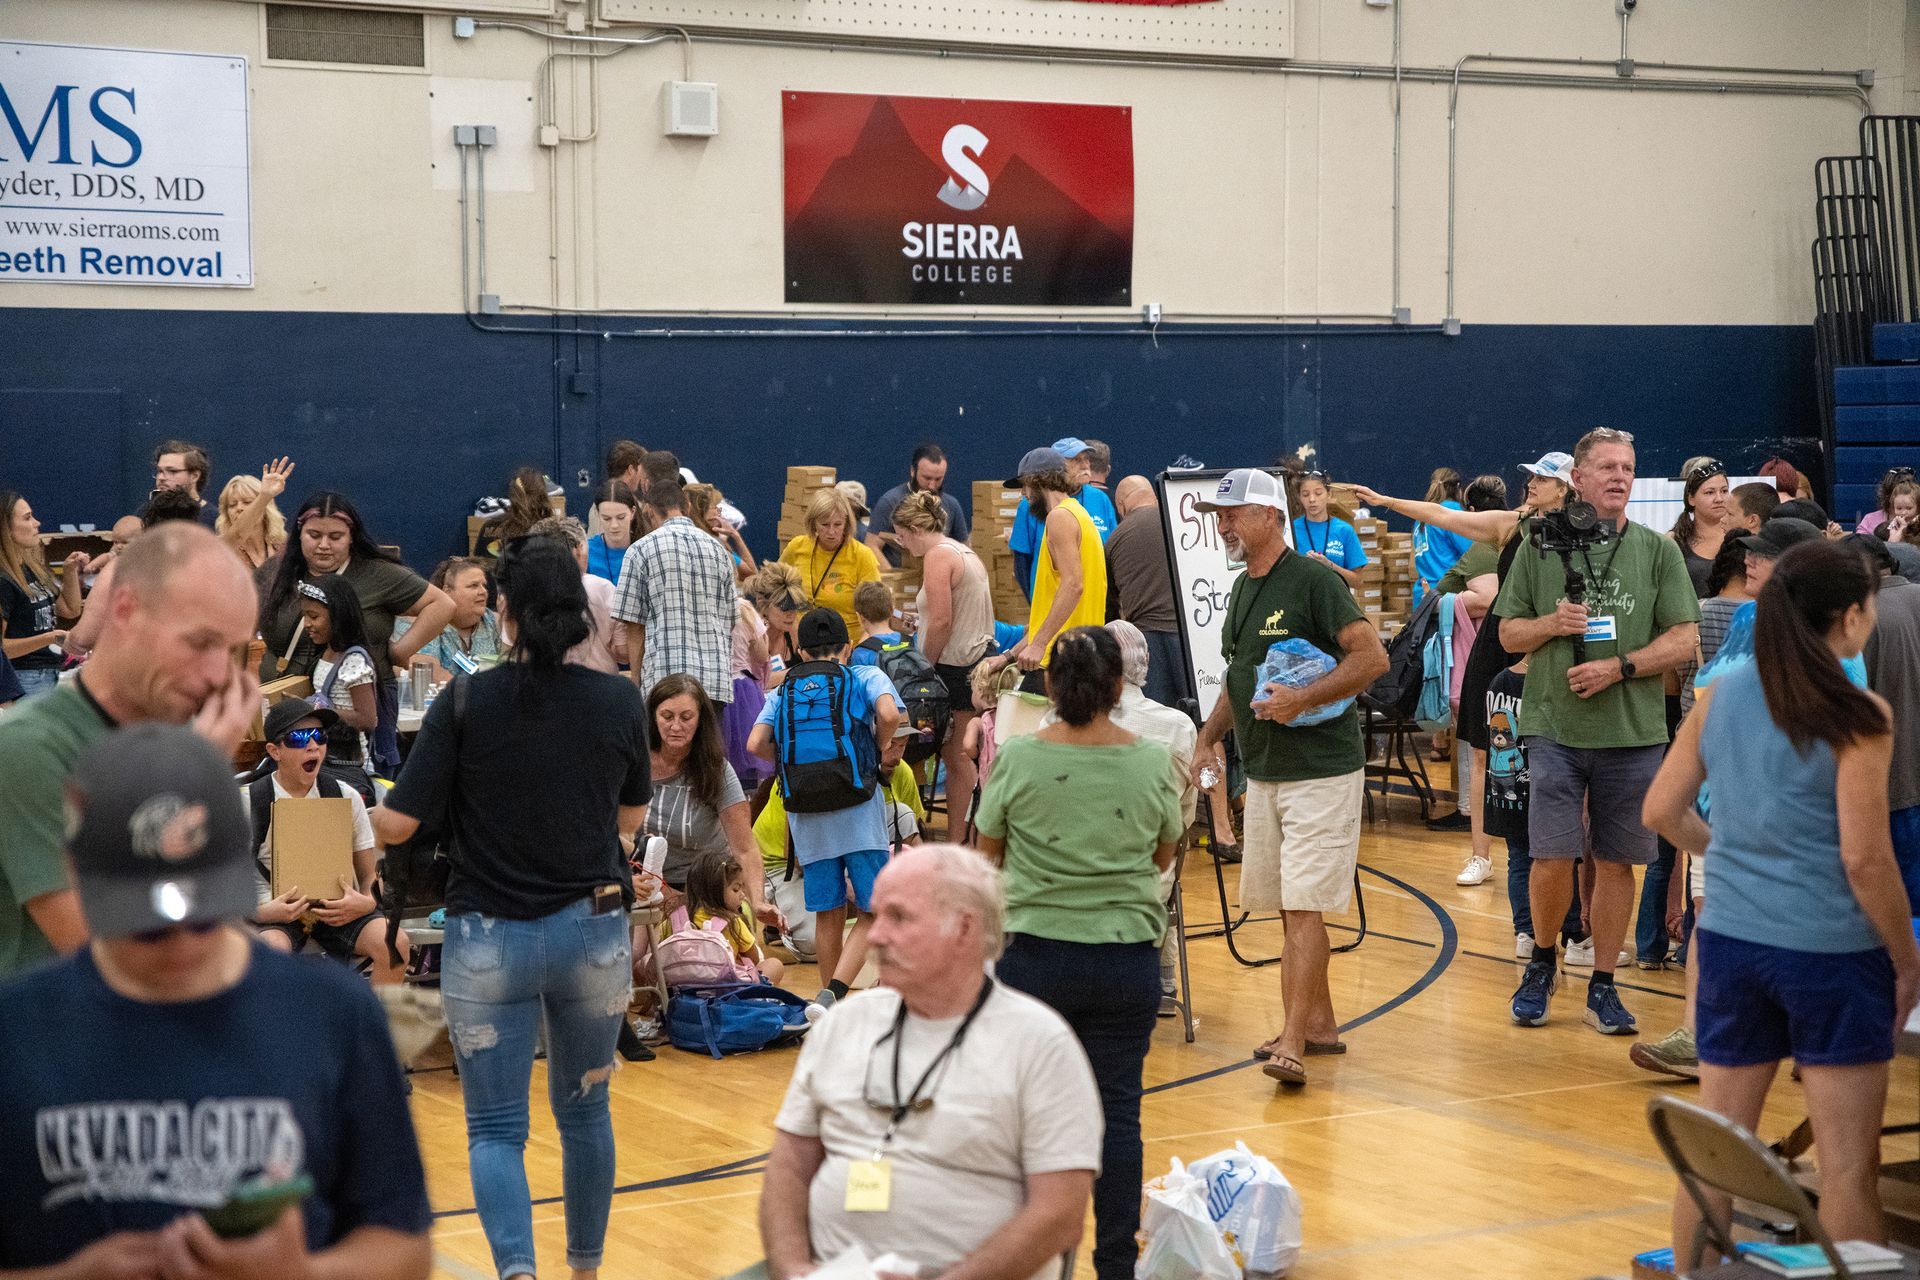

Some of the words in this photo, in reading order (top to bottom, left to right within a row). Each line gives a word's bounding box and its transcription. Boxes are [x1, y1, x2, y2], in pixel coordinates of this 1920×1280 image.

[0, 82, 143, 168] MS
[71, 173, 146, 203] DDS,
[154, 176, 205, 201] MD
[5, 218, 220, 242] www.sierraoms.com
[902, 221, 1023, 260] SIERRA
[0, 246, 65, 273] eeth
[80, 247, 222, 277] Removal
[912, 264, 1013, 283] COLLEGE
